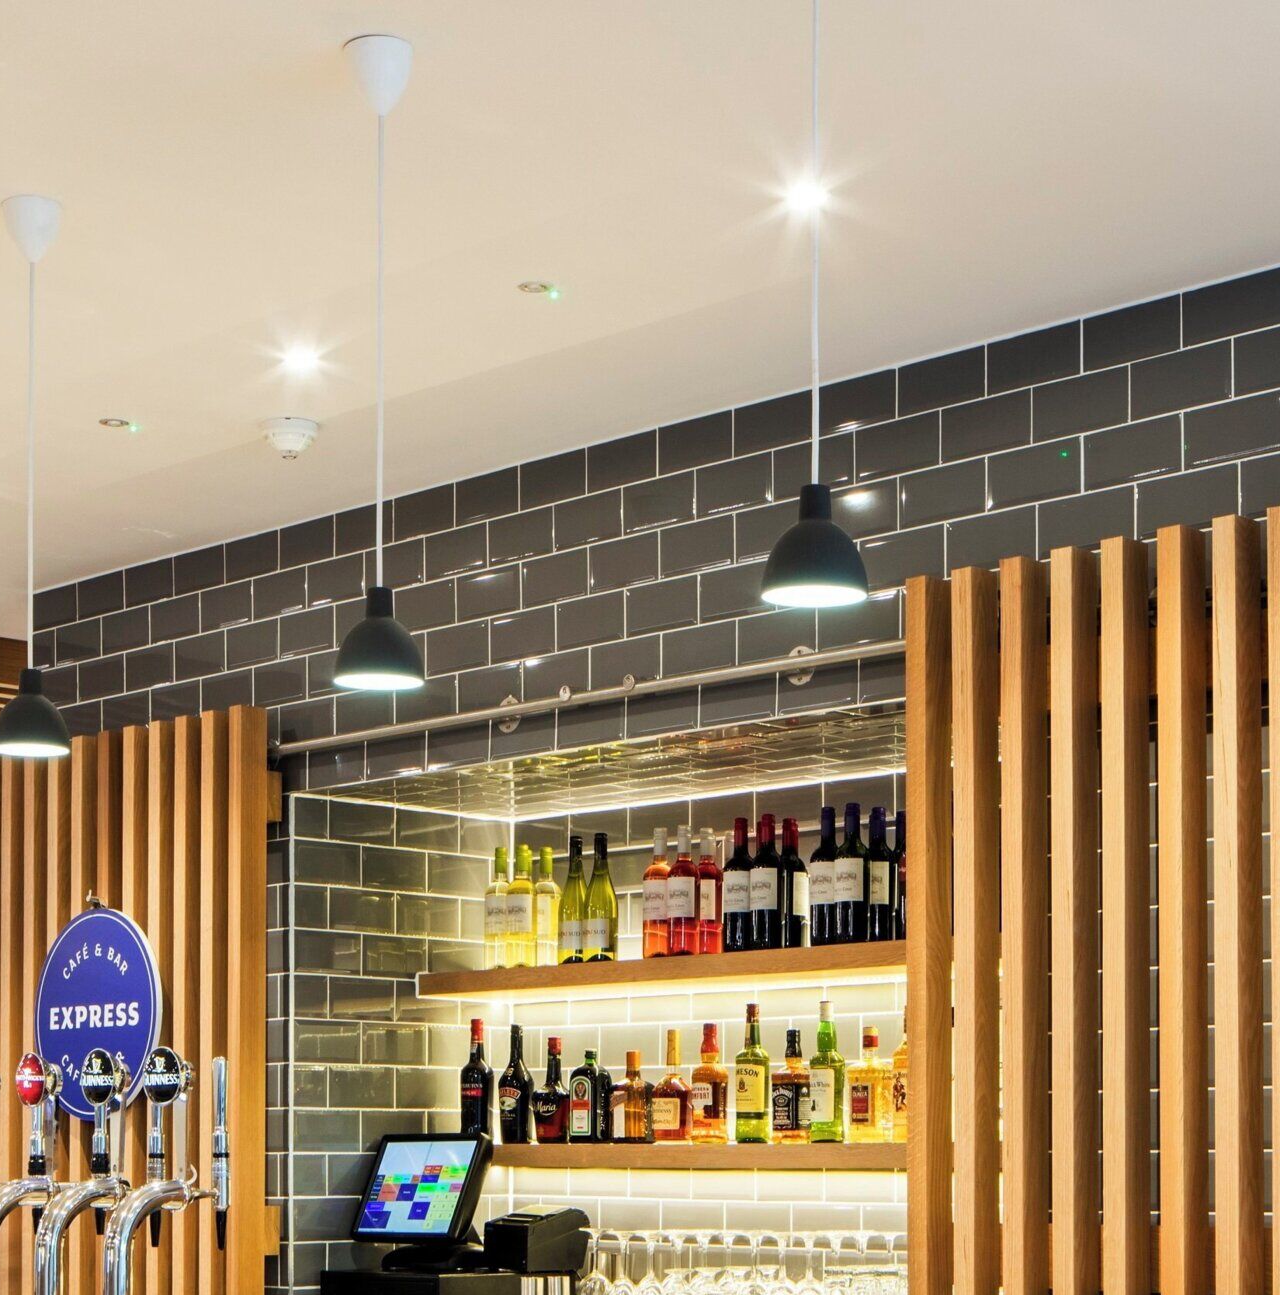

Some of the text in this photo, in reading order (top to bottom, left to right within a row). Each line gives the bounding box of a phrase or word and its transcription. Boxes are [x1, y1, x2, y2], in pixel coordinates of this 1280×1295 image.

[63, 942, 129, 980] CAFÉ & BAR
[50, 1002, 140, 1031] EXPRESS
